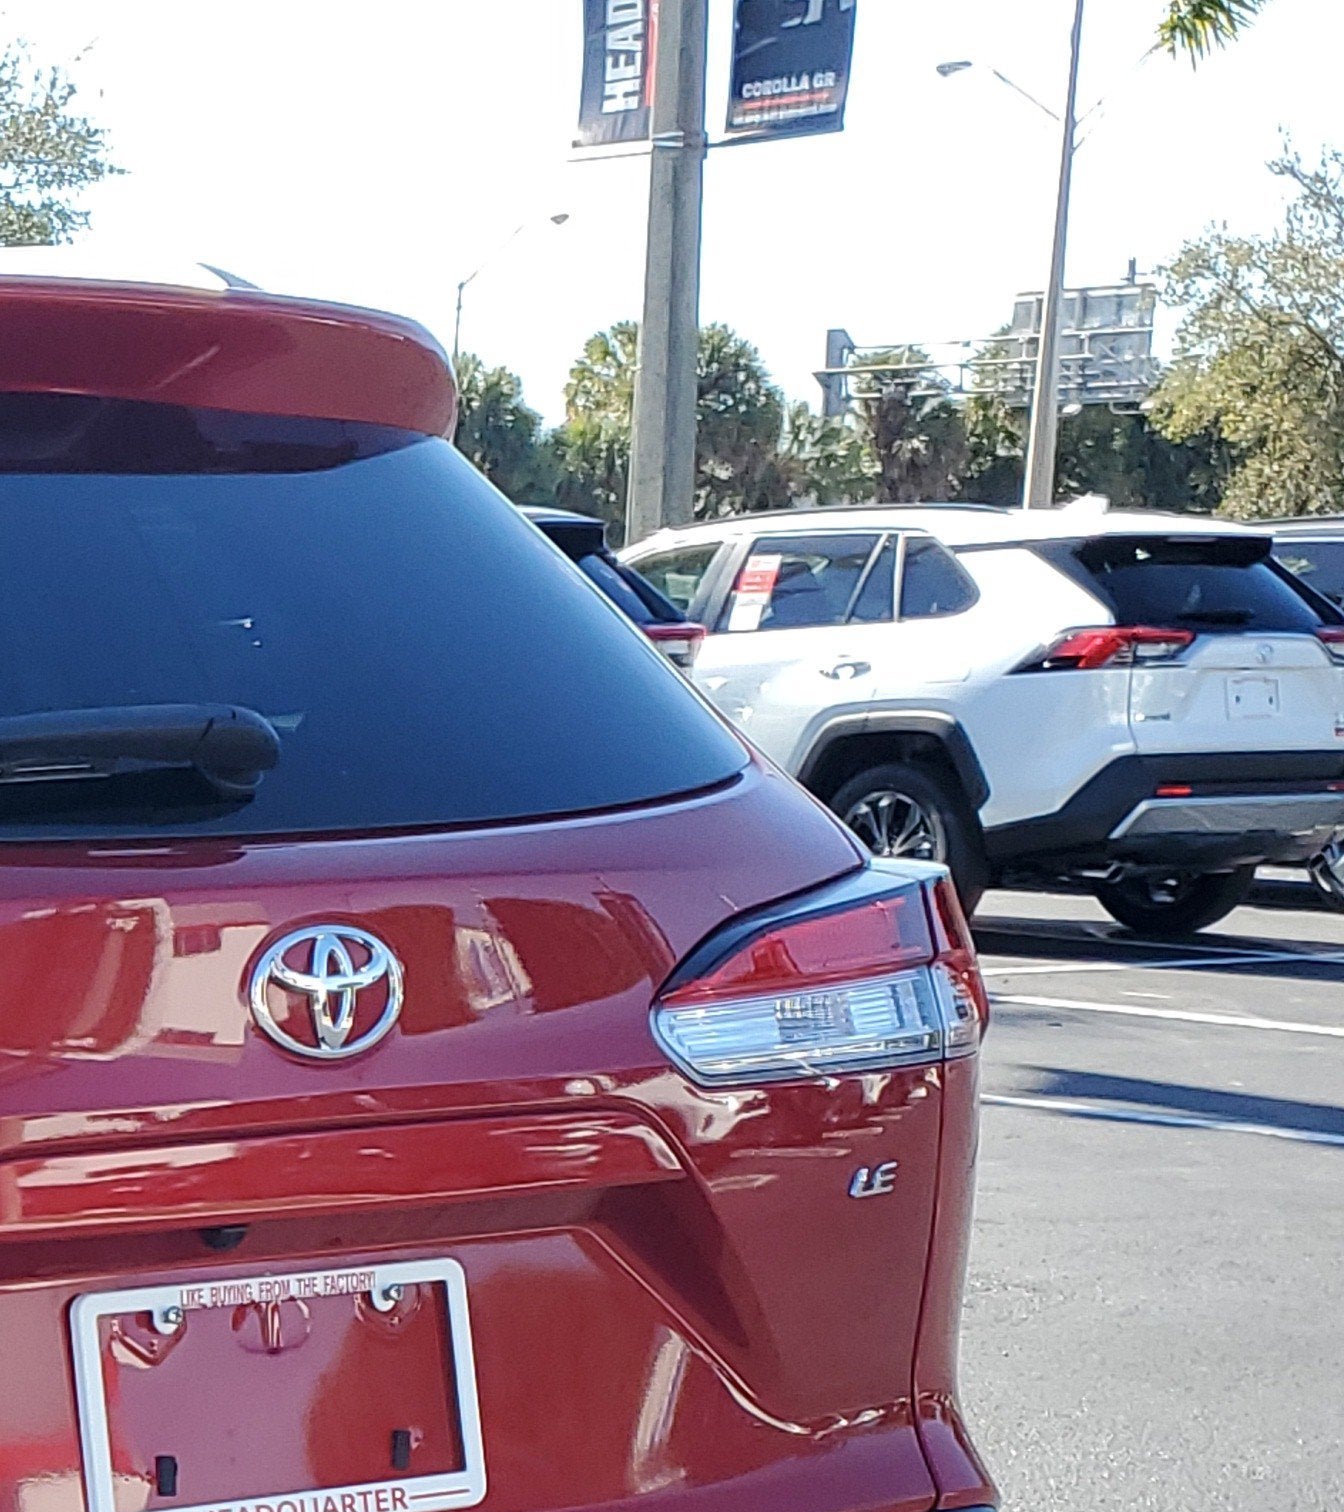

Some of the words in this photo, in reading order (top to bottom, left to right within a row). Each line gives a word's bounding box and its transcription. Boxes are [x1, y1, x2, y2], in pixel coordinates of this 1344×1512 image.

[742, 73, 810, 98] COROLLA
[849, 1161, 898, 1198] LE
[258, 1279, 291, 1300] FROM
[297, 1276, 318, 1296] THE
